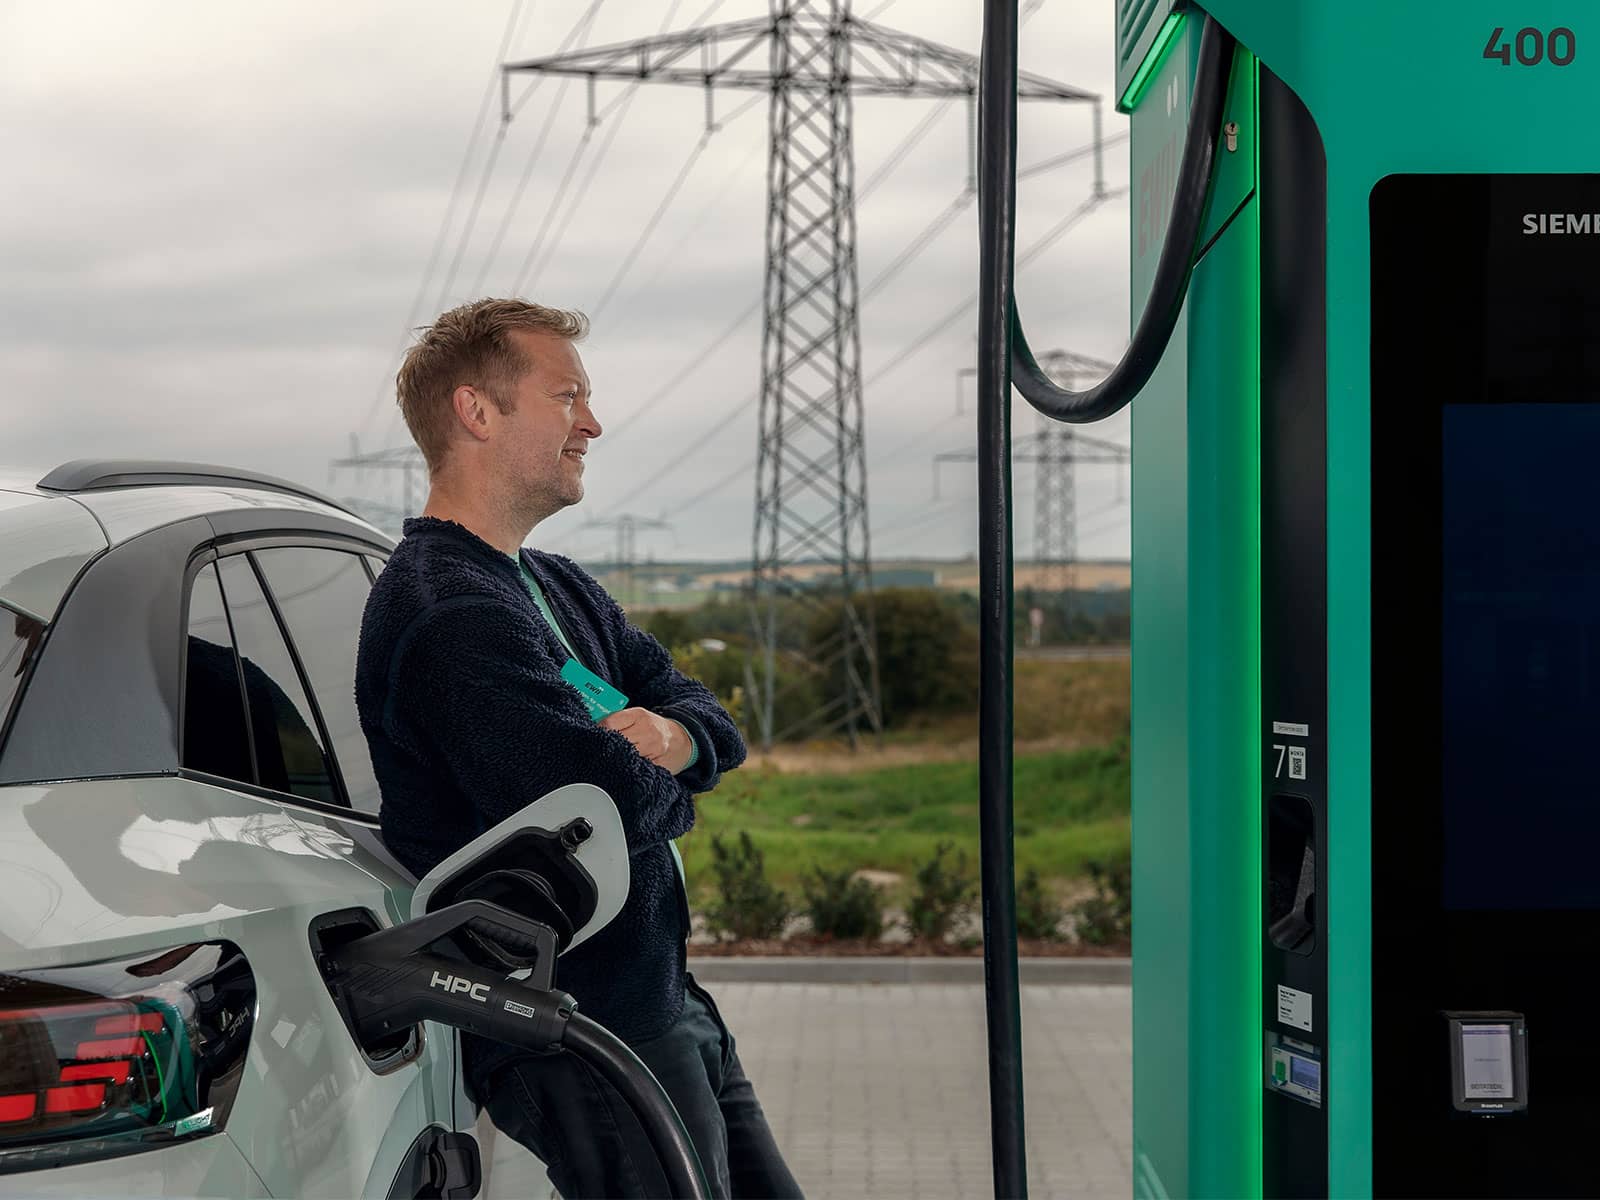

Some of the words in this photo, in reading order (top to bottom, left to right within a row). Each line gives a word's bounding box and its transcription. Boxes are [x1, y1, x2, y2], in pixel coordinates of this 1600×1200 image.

[1483, 26, 1576, 67] 400
[1273, 744, 1286, 778] 7
[429, 970, 491, 1003] HPC
